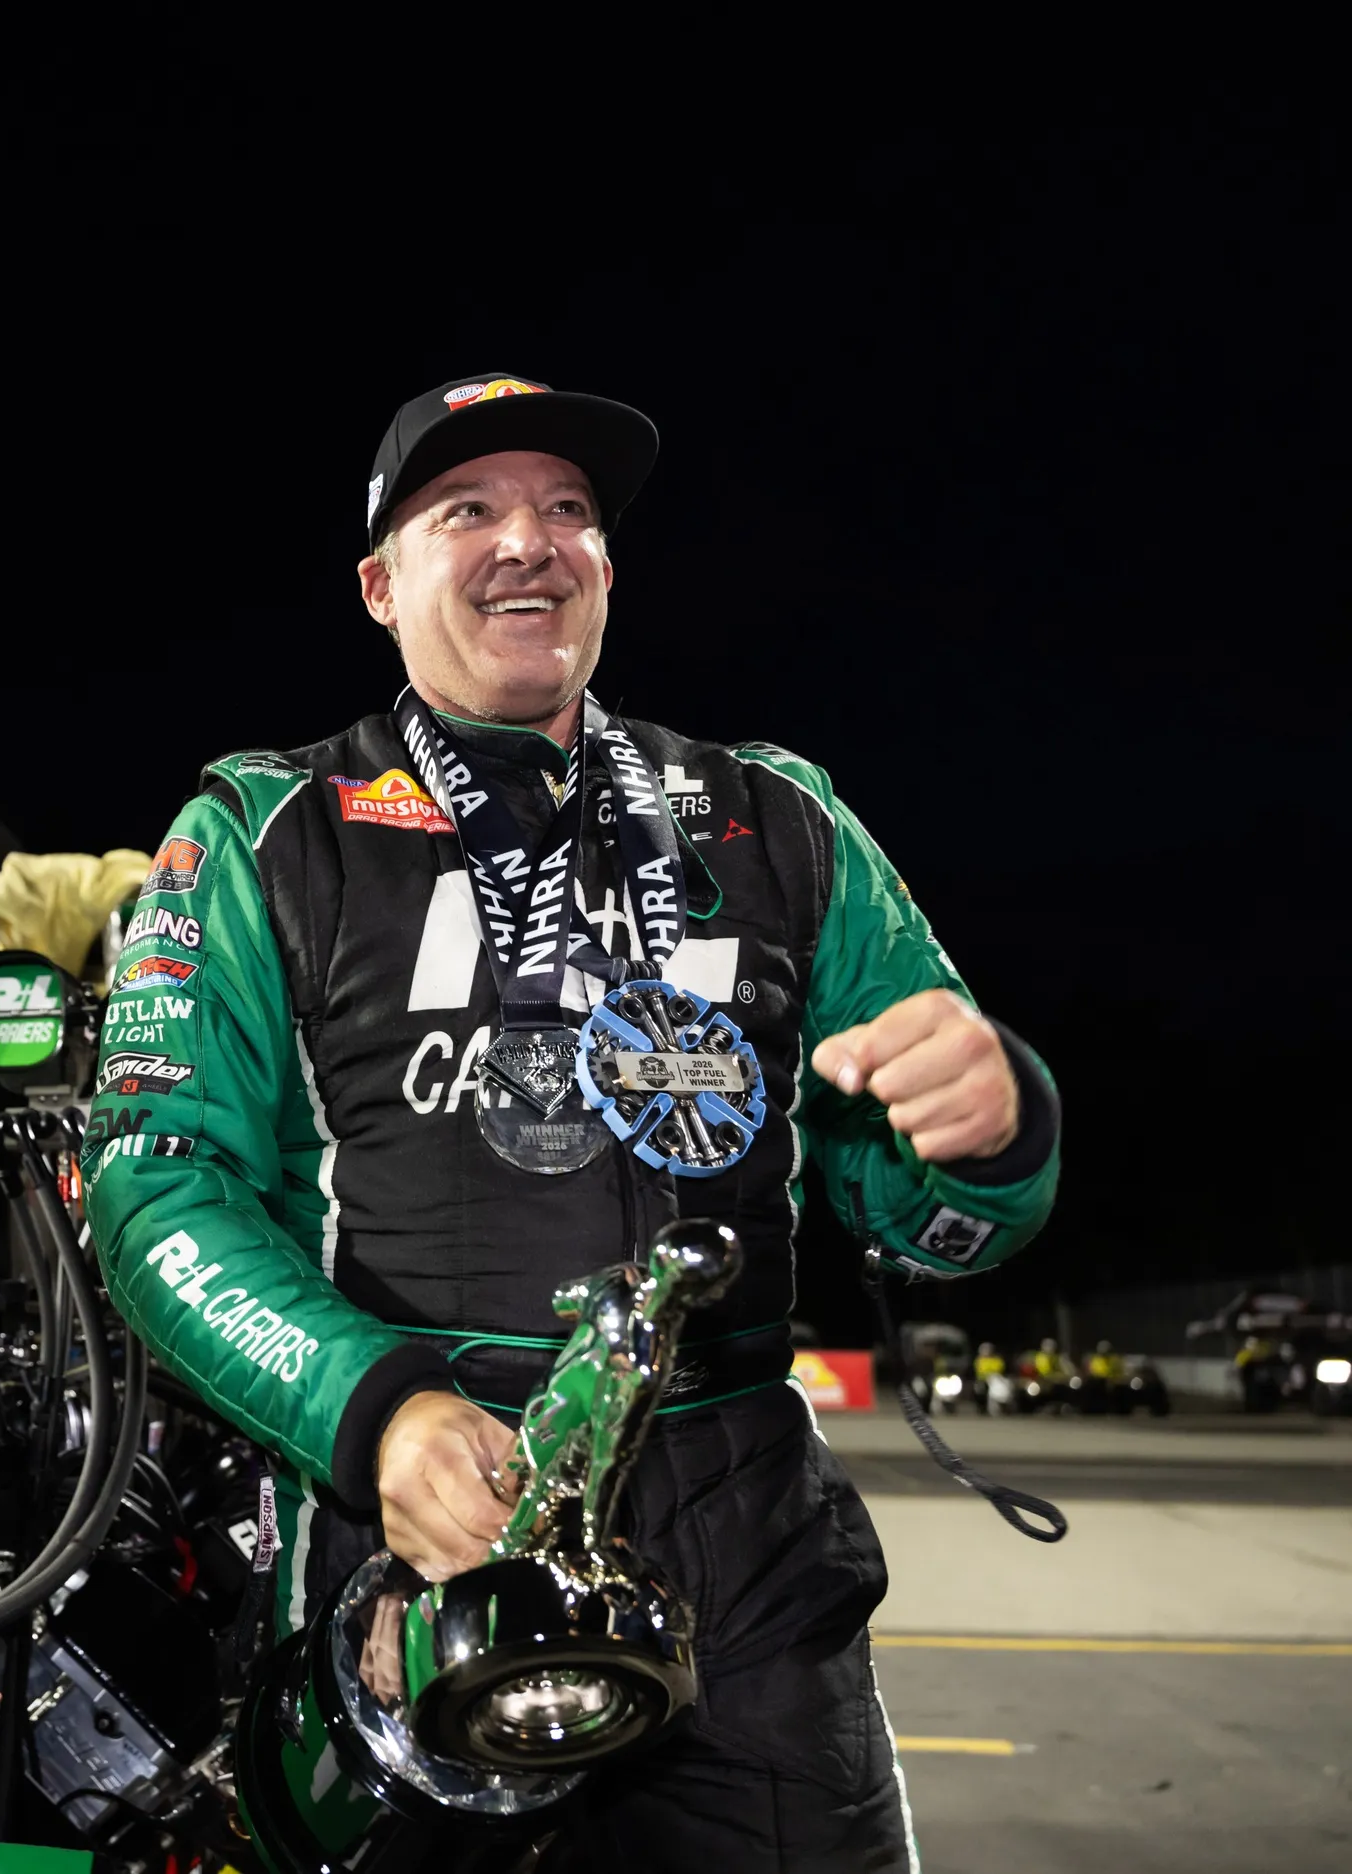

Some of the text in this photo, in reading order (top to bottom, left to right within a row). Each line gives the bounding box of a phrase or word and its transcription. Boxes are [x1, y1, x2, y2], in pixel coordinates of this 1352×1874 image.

[236, 766, 294, 781] SIMPSON
[601, 730, 660, 816] NHRA
[347, 814, 378, 823] DRAG
[379, 817, 422, 828] RACING
[517, 838, 572, 978] NHRA
[105, 996, 195, 1025] UTLAW
[104, 1023, 164, 1045] LIGHT
[692, 1060, 713, 1069] 2026
[683, 1069, 702, 1078] TOP
[704, 1069, 727, 1078] FUEL
[688, 1078, 727, 1087] WINNER
[519, 1123, 586, 1137] WINNER
[164, 1136, 180, 1156] 1
[541, 1141, 568, 1151] 2026
[146, 1229, 319, 1383] R+L CARRIRS
[260, 1494, 273, 1560] SIMPSON
